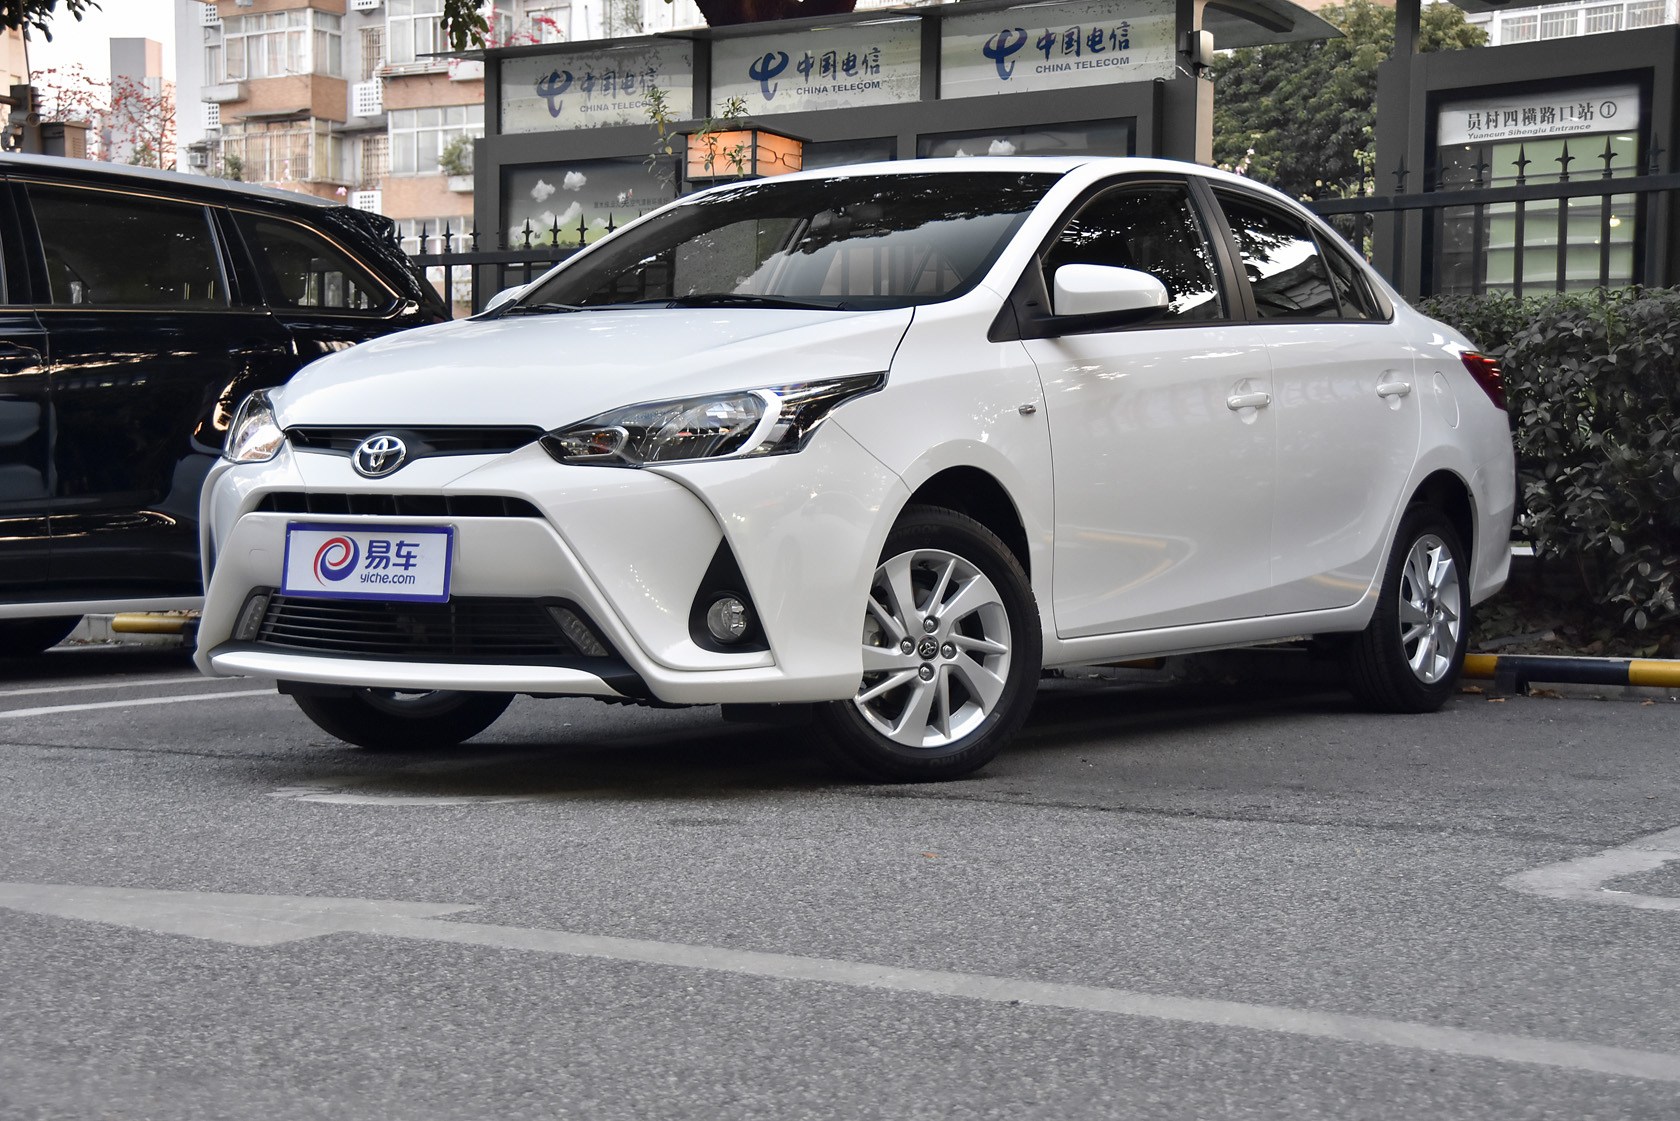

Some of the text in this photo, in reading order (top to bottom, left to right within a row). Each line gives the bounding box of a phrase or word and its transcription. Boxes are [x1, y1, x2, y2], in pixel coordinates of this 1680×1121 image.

[1036, 21, 1130, 61] 中国电信
[797, 47, 880, 84] 中国电信
[1035, 57, 1130, 74] CHINA TELECOM
[796, 81, 880, 96] CHINA TELECOM
[579, 100, 653, 113] CHINA TELECO
[1467, 102, 1594, 131] 员村四横路口站
[1467, 132, 1505, 140] Yuancun
[1549, 124, 1591, 133] Entrance
[365, 540, 420, 571] 易车
[360, 572, 416, 585] yiche.com
